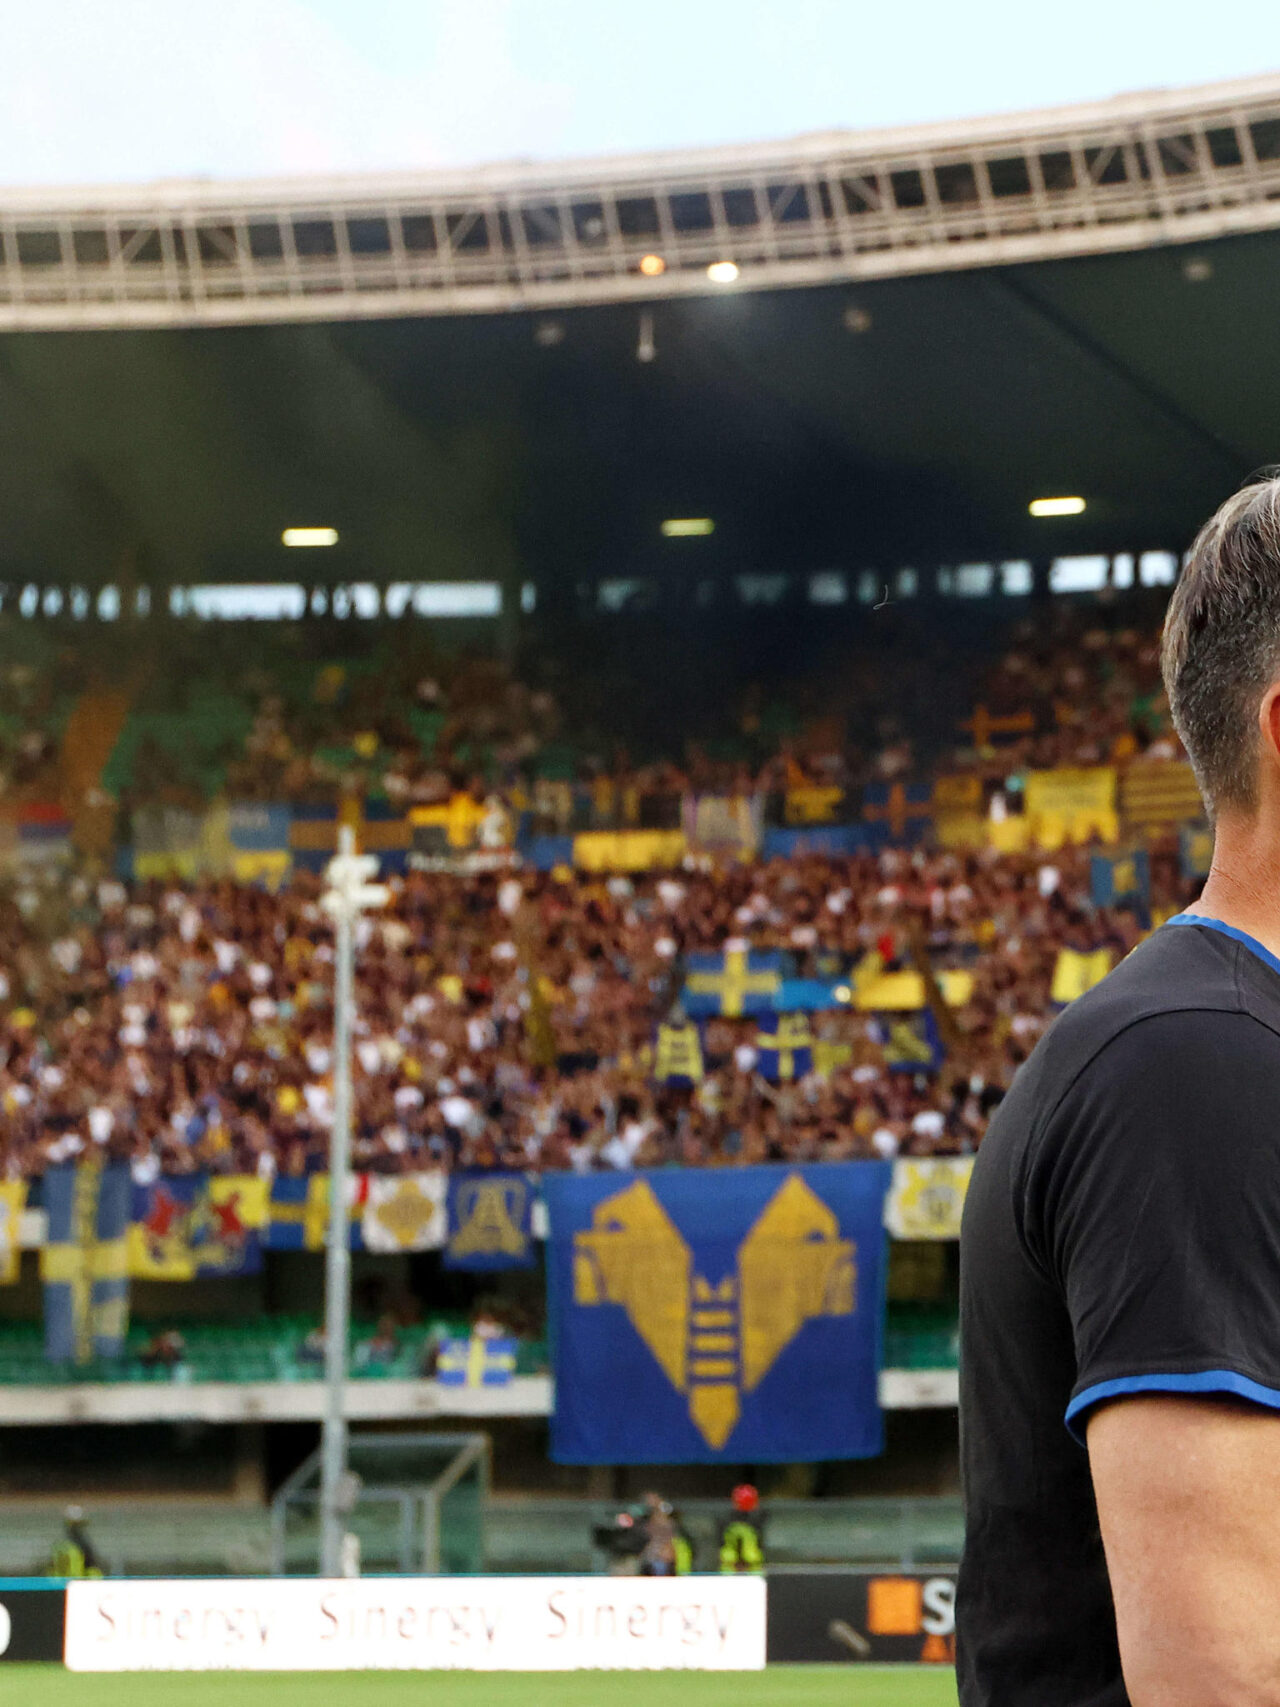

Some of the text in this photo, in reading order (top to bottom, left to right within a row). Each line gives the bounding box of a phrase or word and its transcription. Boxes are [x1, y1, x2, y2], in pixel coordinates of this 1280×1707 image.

[96, 1589, 734, 1653] Sinergy Sinergy Sinergy
